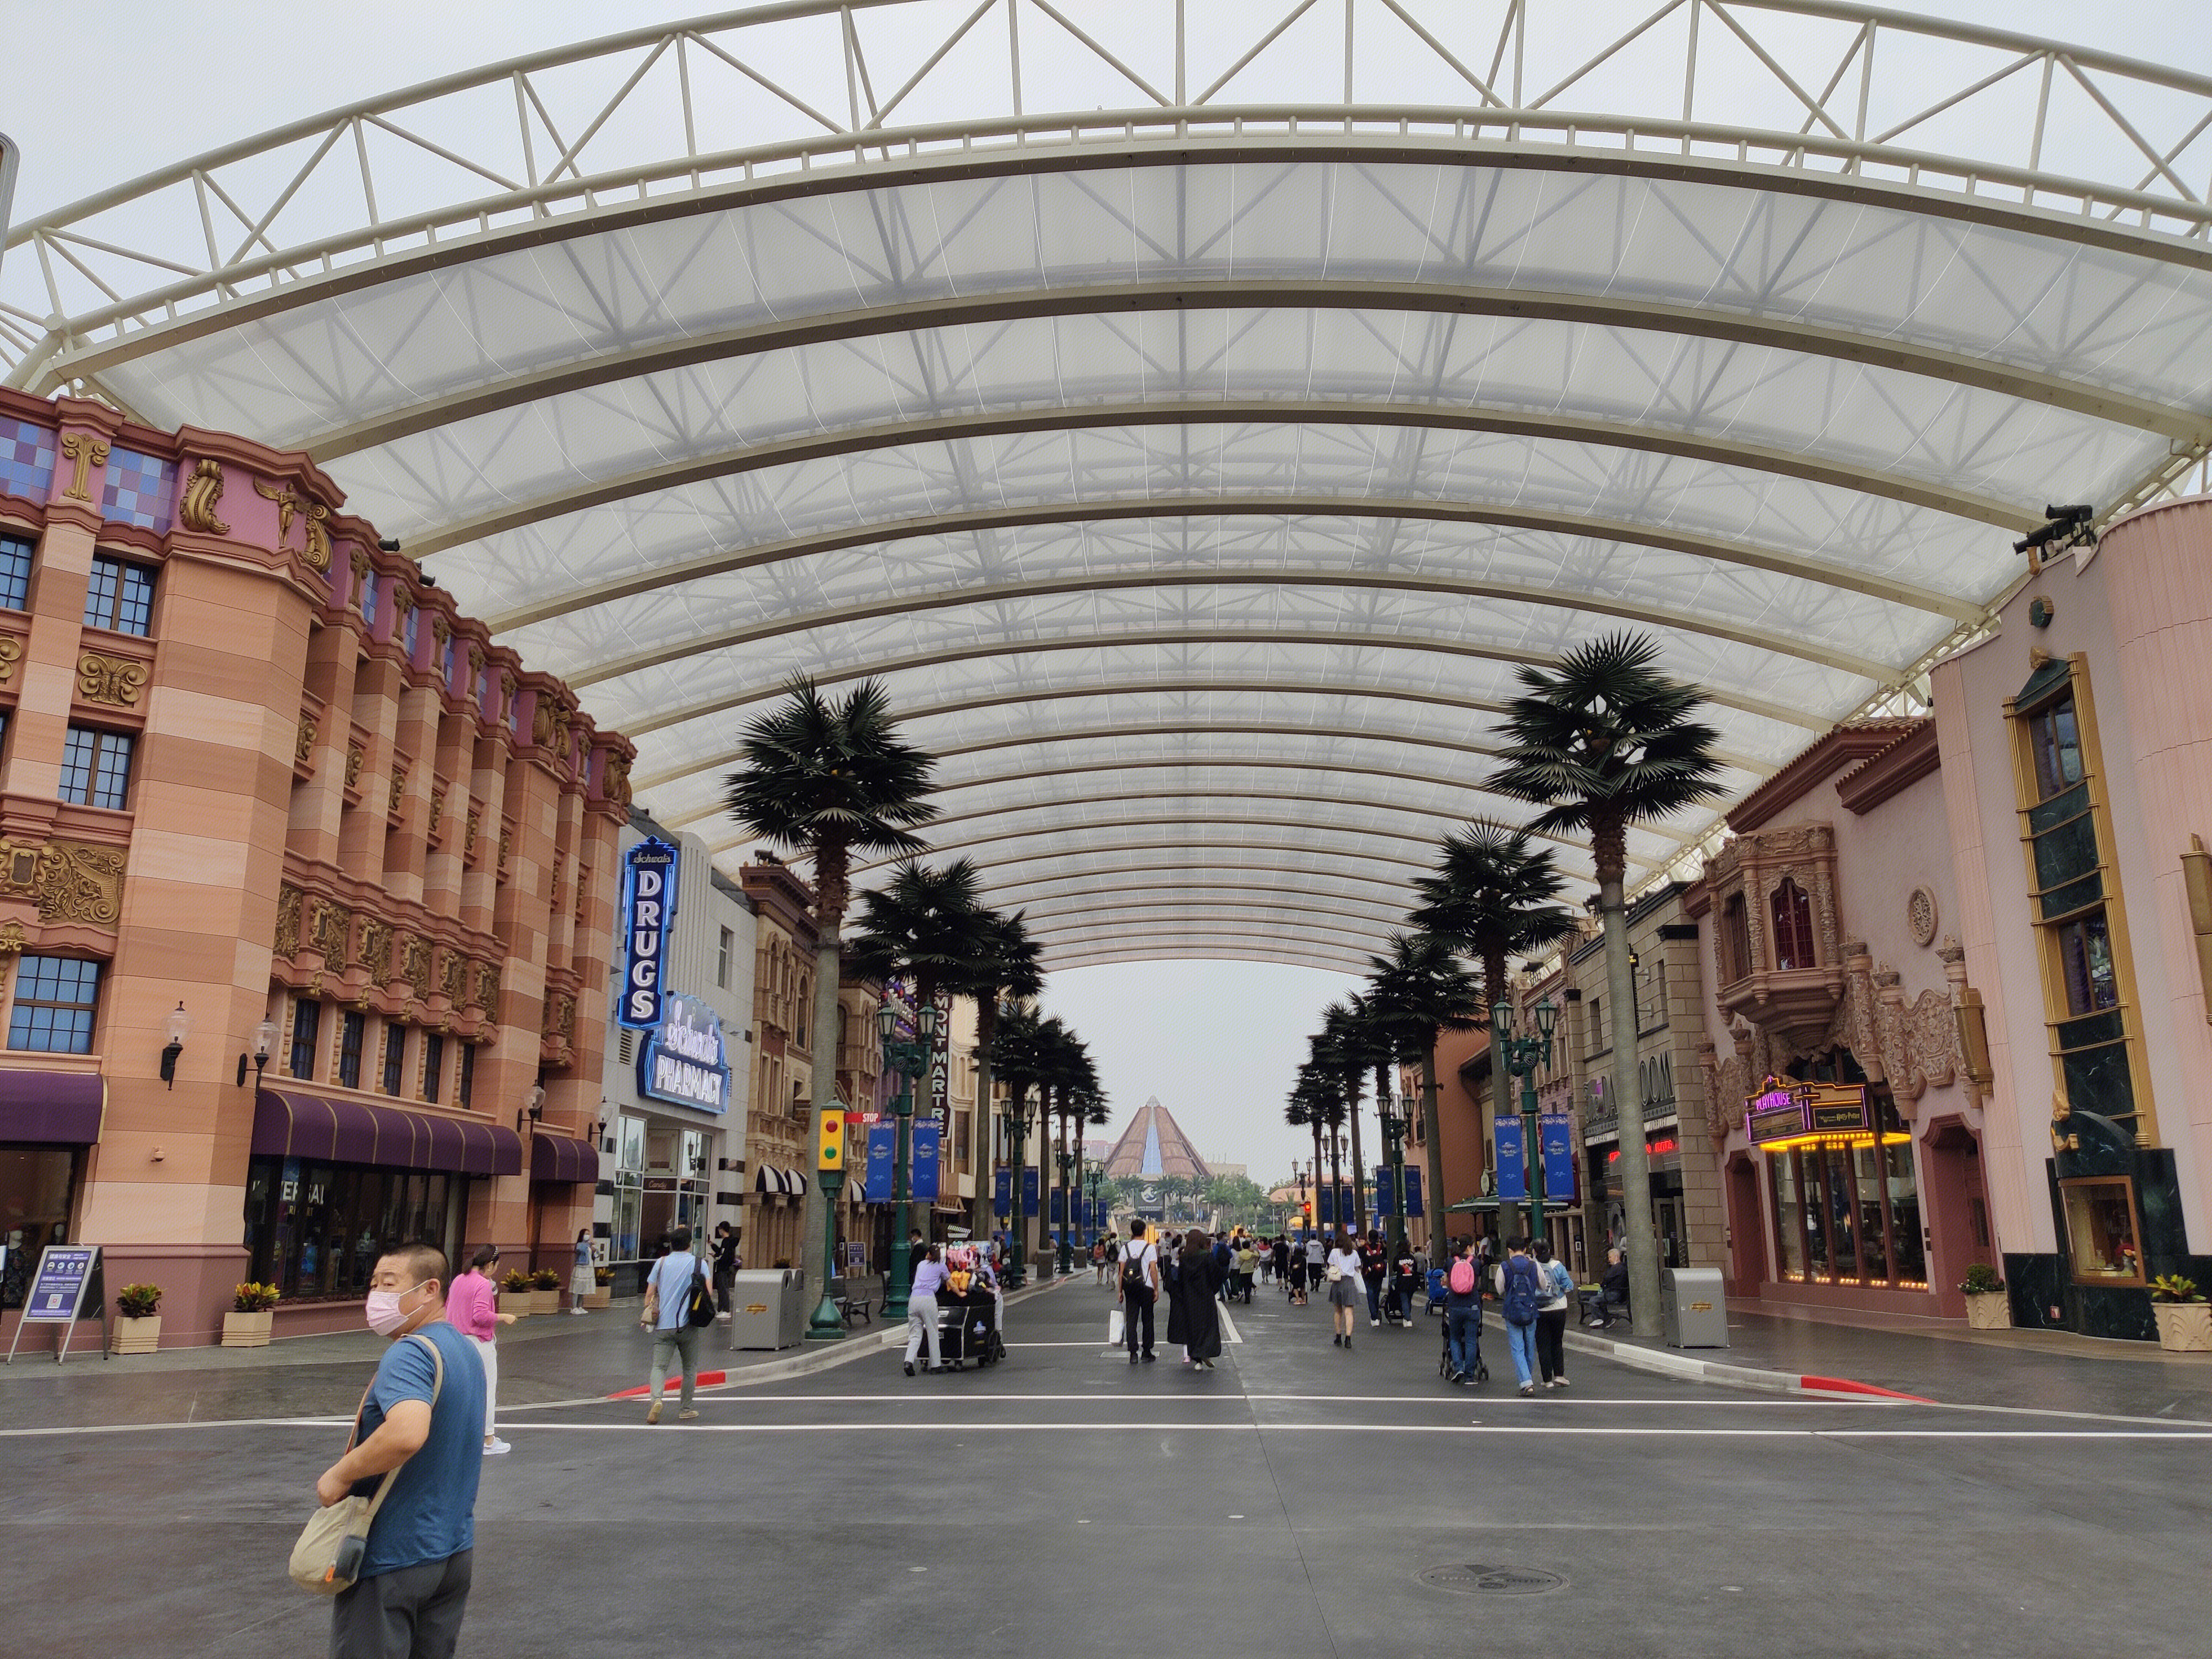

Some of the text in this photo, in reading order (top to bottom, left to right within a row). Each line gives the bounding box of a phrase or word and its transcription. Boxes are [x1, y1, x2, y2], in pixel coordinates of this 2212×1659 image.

[630, 870, 662, 1018] DRUGS
[655, 1055, 722, 1105] PHARMACY
[1756, 1092, 1791, 1111] PLAYHOUSE
[862, 1113, 879, 1123] STOP
[649, 1180, 667, 1190] Candy
